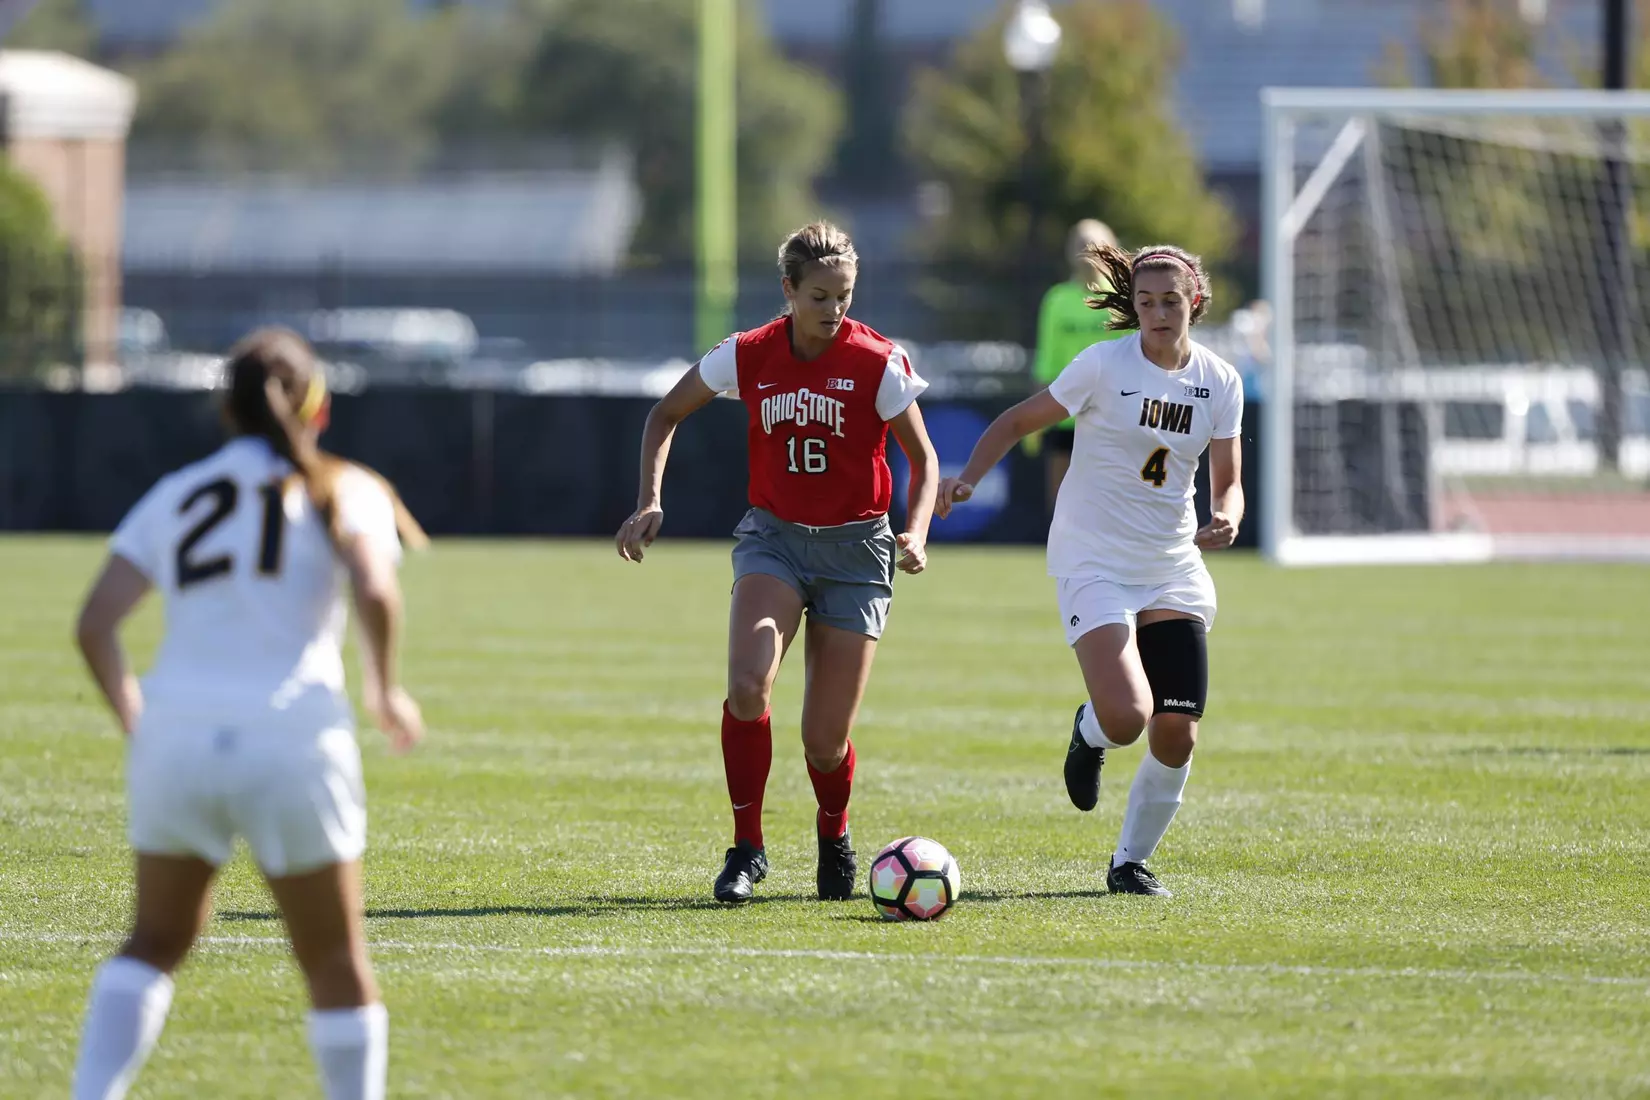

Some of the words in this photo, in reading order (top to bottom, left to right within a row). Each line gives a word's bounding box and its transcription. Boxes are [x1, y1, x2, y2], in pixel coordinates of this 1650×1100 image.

[1139, 397, 1194, 435] IOWA
[785, 435, 828, 474] 16
[1140, 445, 1171, 488] 4
[174, 476, 284, 589] 21
[1168, 698, 1197, 709] Mueller
